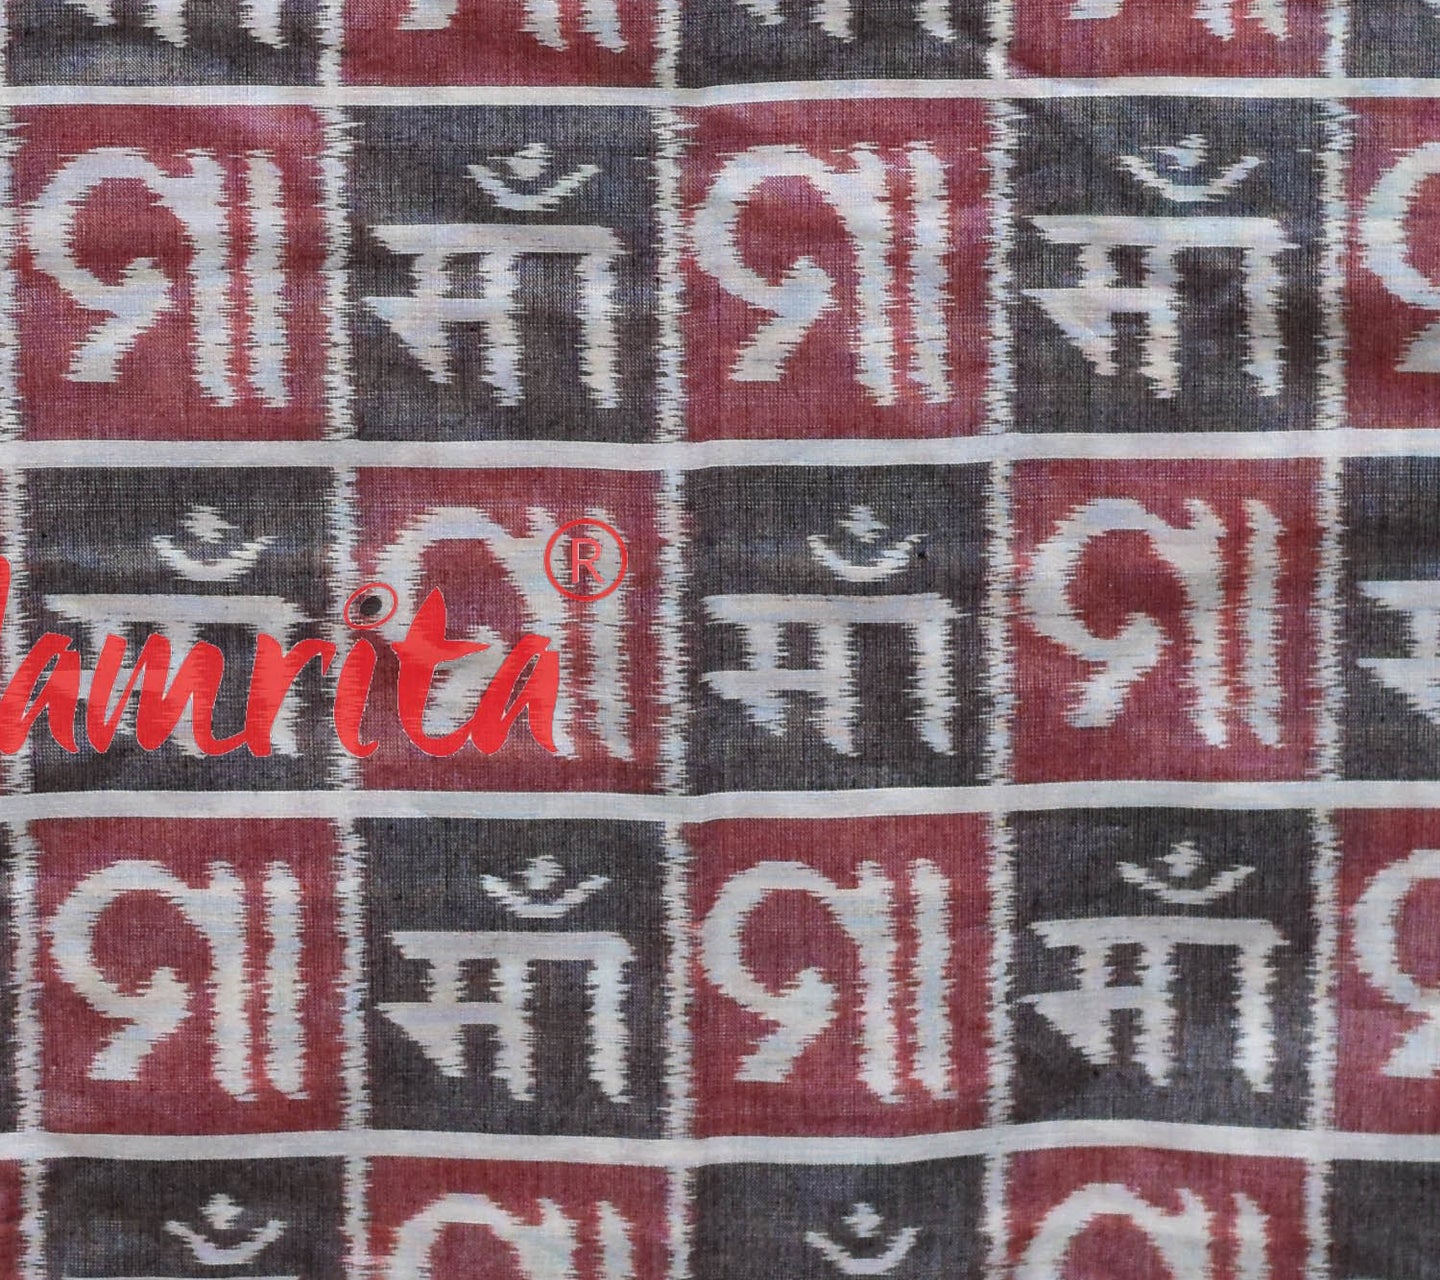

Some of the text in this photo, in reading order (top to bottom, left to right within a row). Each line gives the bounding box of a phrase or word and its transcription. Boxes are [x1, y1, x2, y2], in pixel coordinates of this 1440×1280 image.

[364, 141, 621, 409] माँ
[1024, 135, 1295, 398] माँ
[705, 505, 959, 754] माँ
[1023, 842, 1282, 1093] माँ
